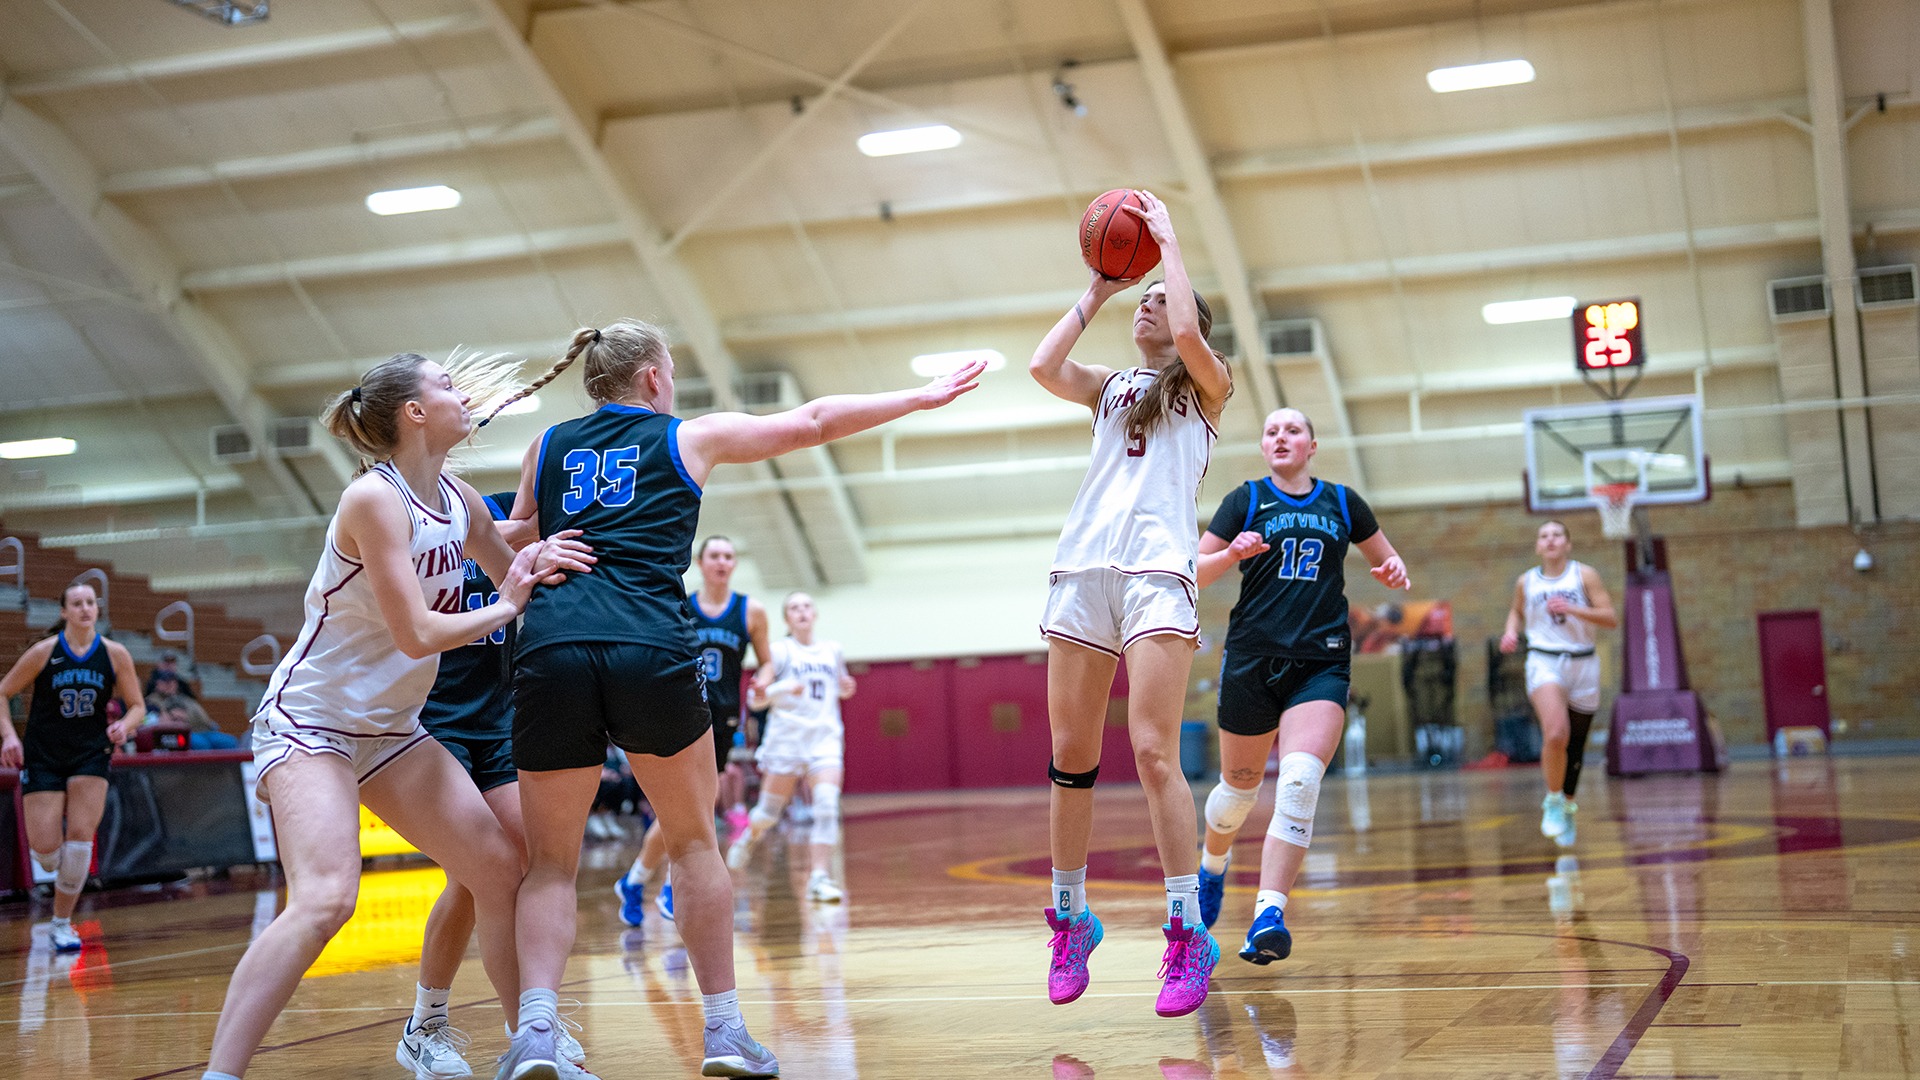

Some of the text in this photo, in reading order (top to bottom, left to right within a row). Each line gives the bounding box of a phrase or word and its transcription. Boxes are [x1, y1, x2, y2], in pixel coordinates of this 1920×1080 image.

[1586, 327, 1632, 367] 25
[1104, 387, 1188, 418] VIKS
[562, 445, 640, 515] 35
[1265, 512, 1340, 541] MAYVILLE
[1278, 537, 1325, 581] 12
[51, 668, 104, 689] MAYVILLE
[59, 688, 97, 718] 32
